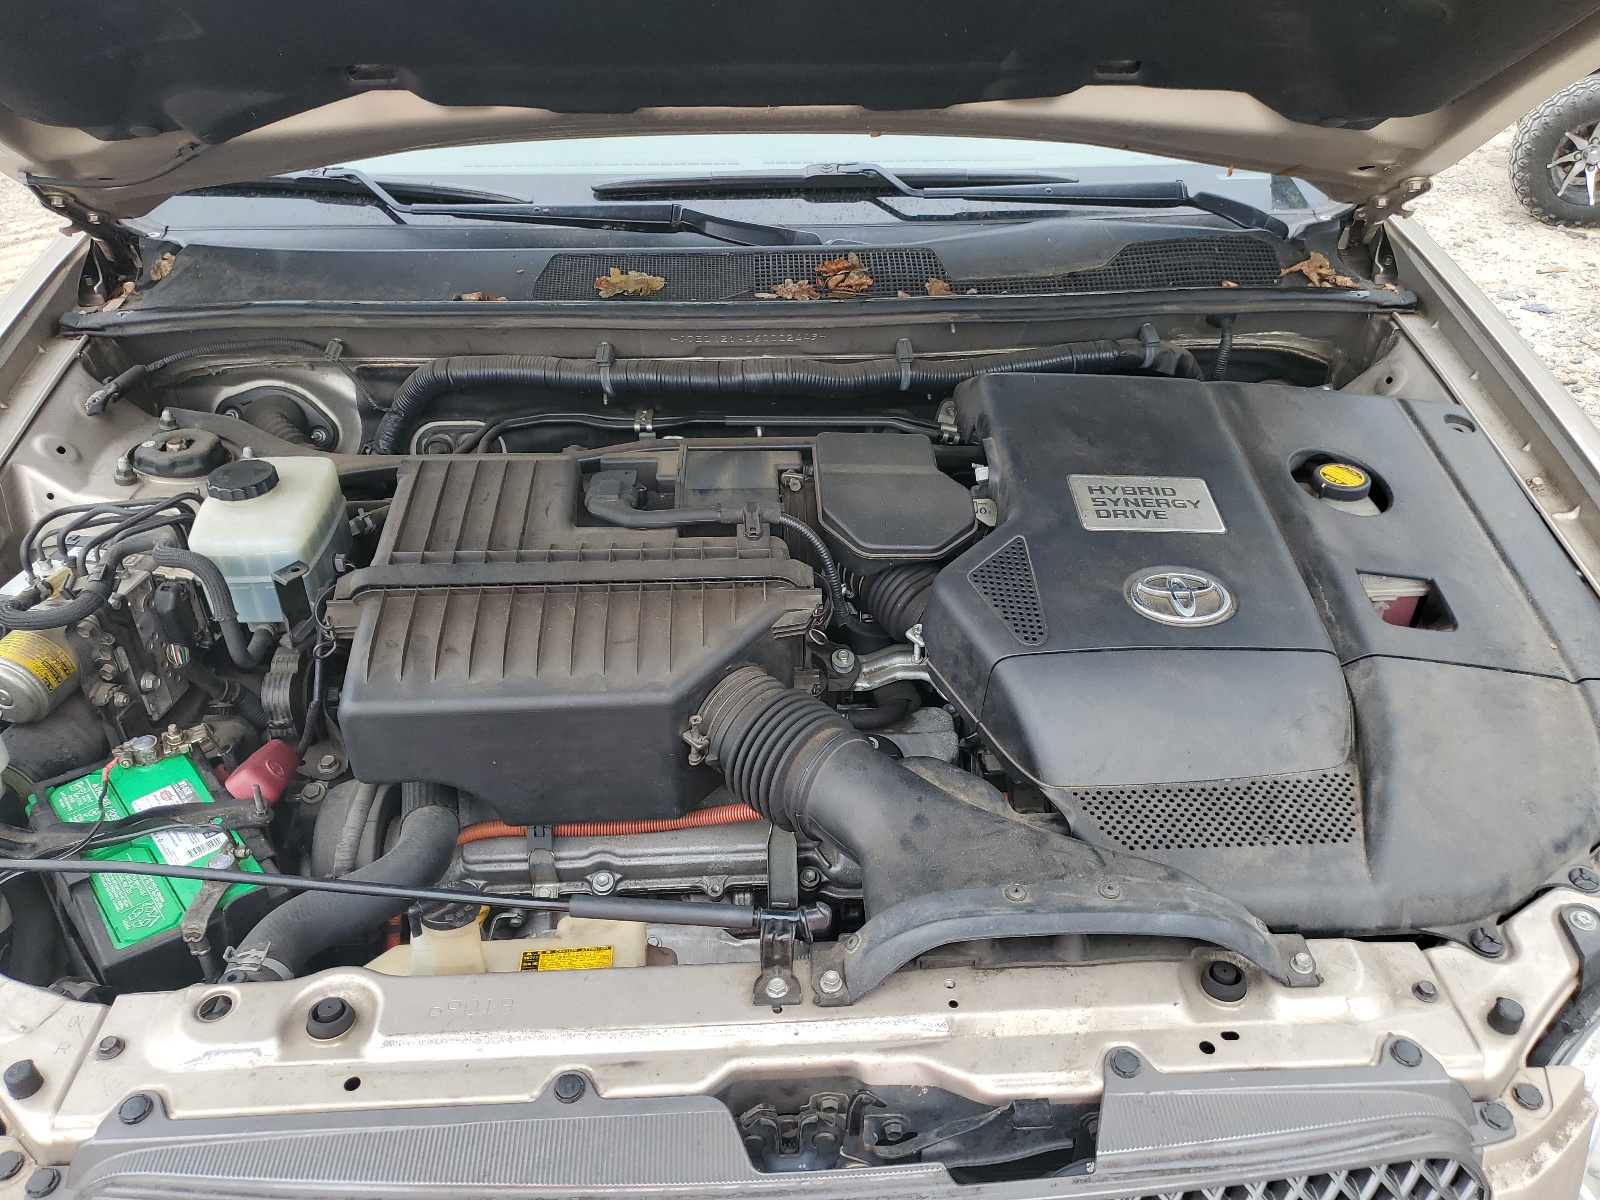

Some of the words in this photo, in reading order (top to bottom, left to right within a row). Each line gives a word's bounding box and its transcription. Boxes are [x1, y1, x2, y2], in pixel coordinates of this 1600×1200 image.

[1087, 485, 1177, 496] HYBRID
[1091, 497, 1201, 509] SYNERGY
[1095, 509, 1169, 520] DRIVE
[429, 997, 514, 1017] 69018
